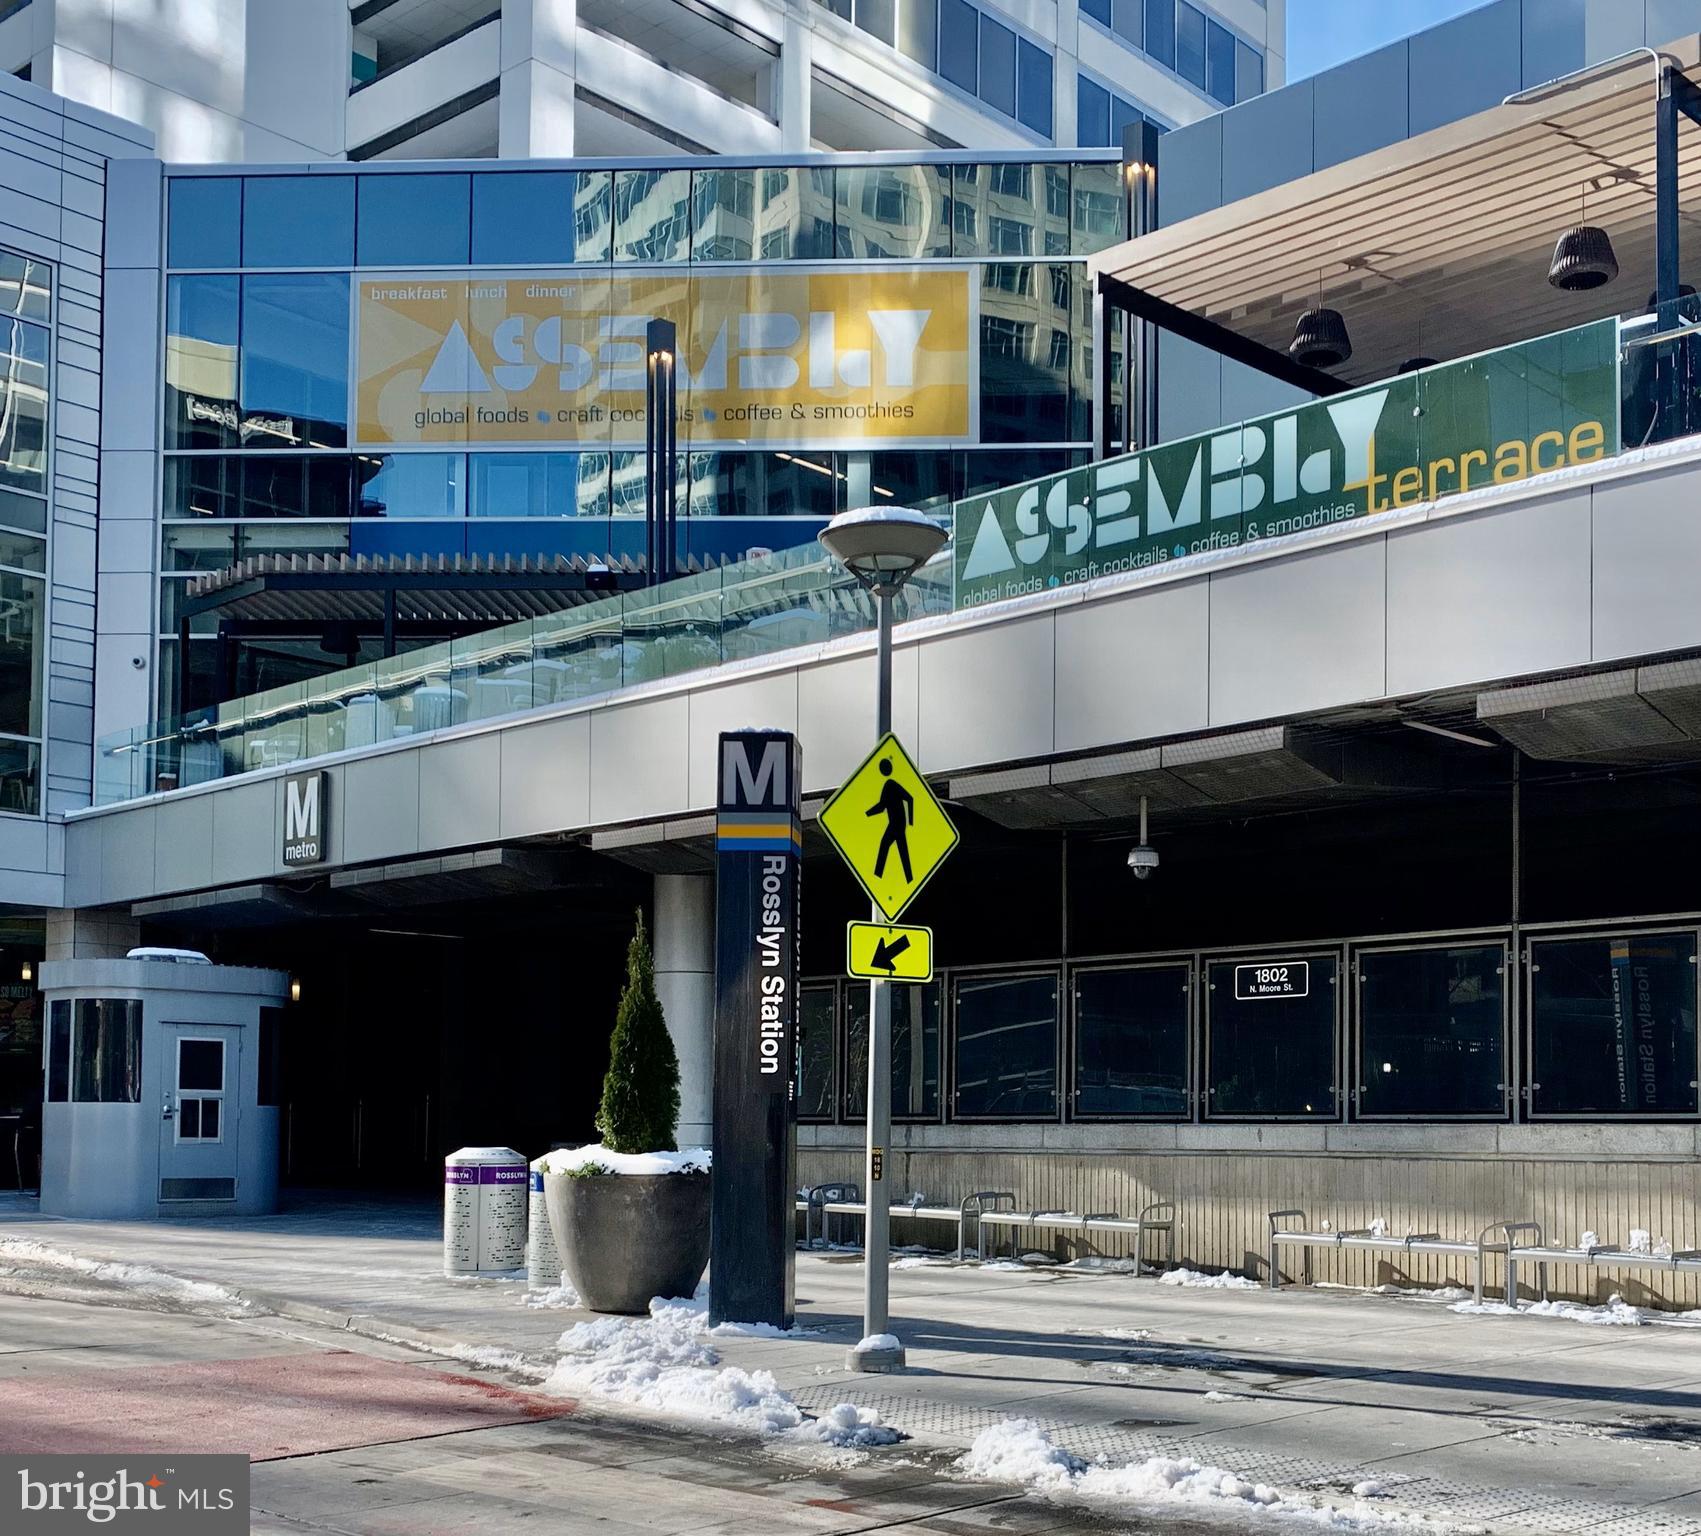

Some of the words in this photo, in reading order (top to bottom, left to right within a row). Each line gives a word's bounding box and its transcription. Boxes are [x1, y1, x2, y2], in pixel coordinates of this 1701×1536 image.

[371, 286, 448, 300] breakfast
[465, 285, 508, 299] lunch
[525, 284, 577, 298] dinner
[418, 309, 933, 393] ASSEMBLY
[414, 407, 469, 429] global
[477, 406, 530, 424] foods
[557, 405, 603, 423] craft
[723, 403, 783, 422] coffee
[790, 403, 805, 420] &
[813, 400, 915, 420] smoothies
[961, 388, 1390, 582] ASSEMBLY
[1342, 420, 1605, 514] terrace
[962, 584, 1000, 607] global
[1005, 575, 1043, 598] foods
[1064, 562, 1099, 585] craft
[1103, 545, 1168, 576] cocktails
[1190, 530, 1240, 555] coffee
[1246, 522, 1260, 541] &
[1266, 502, 1356, 537] smoothies
[722, 740, 787, 806] M
[286, 776, 319, 841] M
[286, 842, 317, 860] metro
[756, 855, 787, 967] Rosslyn
[1249, 985, 1257, 993] N.
[1259, 984, 1281, 993] Moore
[1283, 983, 1293, 992] St.
[1254, 967, 1289, 983] 1802
[760, 975, 786, 1074] Station
